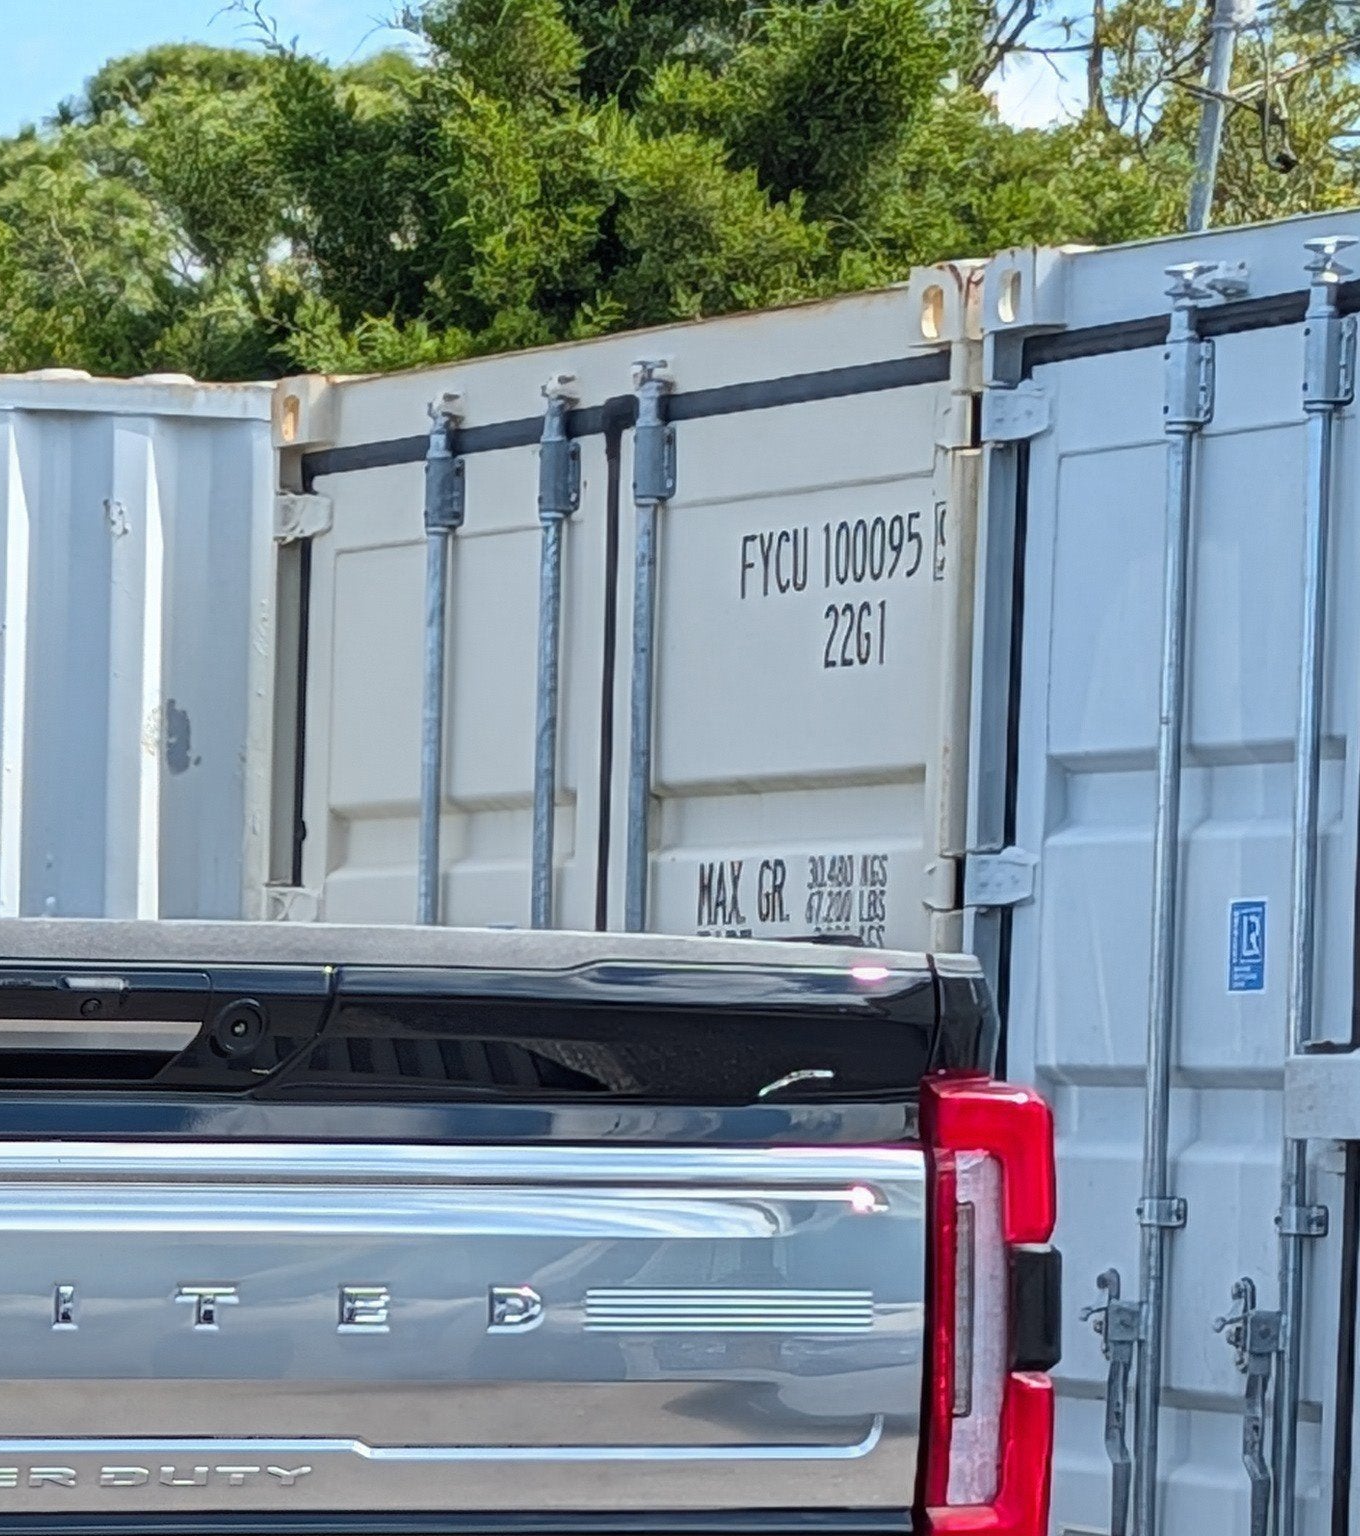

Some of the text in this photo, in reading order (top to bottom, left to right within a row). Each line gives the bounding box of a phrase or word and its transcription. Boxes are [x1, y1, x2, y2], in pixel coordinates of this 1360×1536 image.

[741, 526, 808, 600] FYCU
[823, 511, 923, 588] 100095
[824, 600, 886, 669] 22G1
[758, 858, 790, 922] GR.
[859, 889, 887, 922] LBS
[99, 1464, 312, 1488] DUTY
